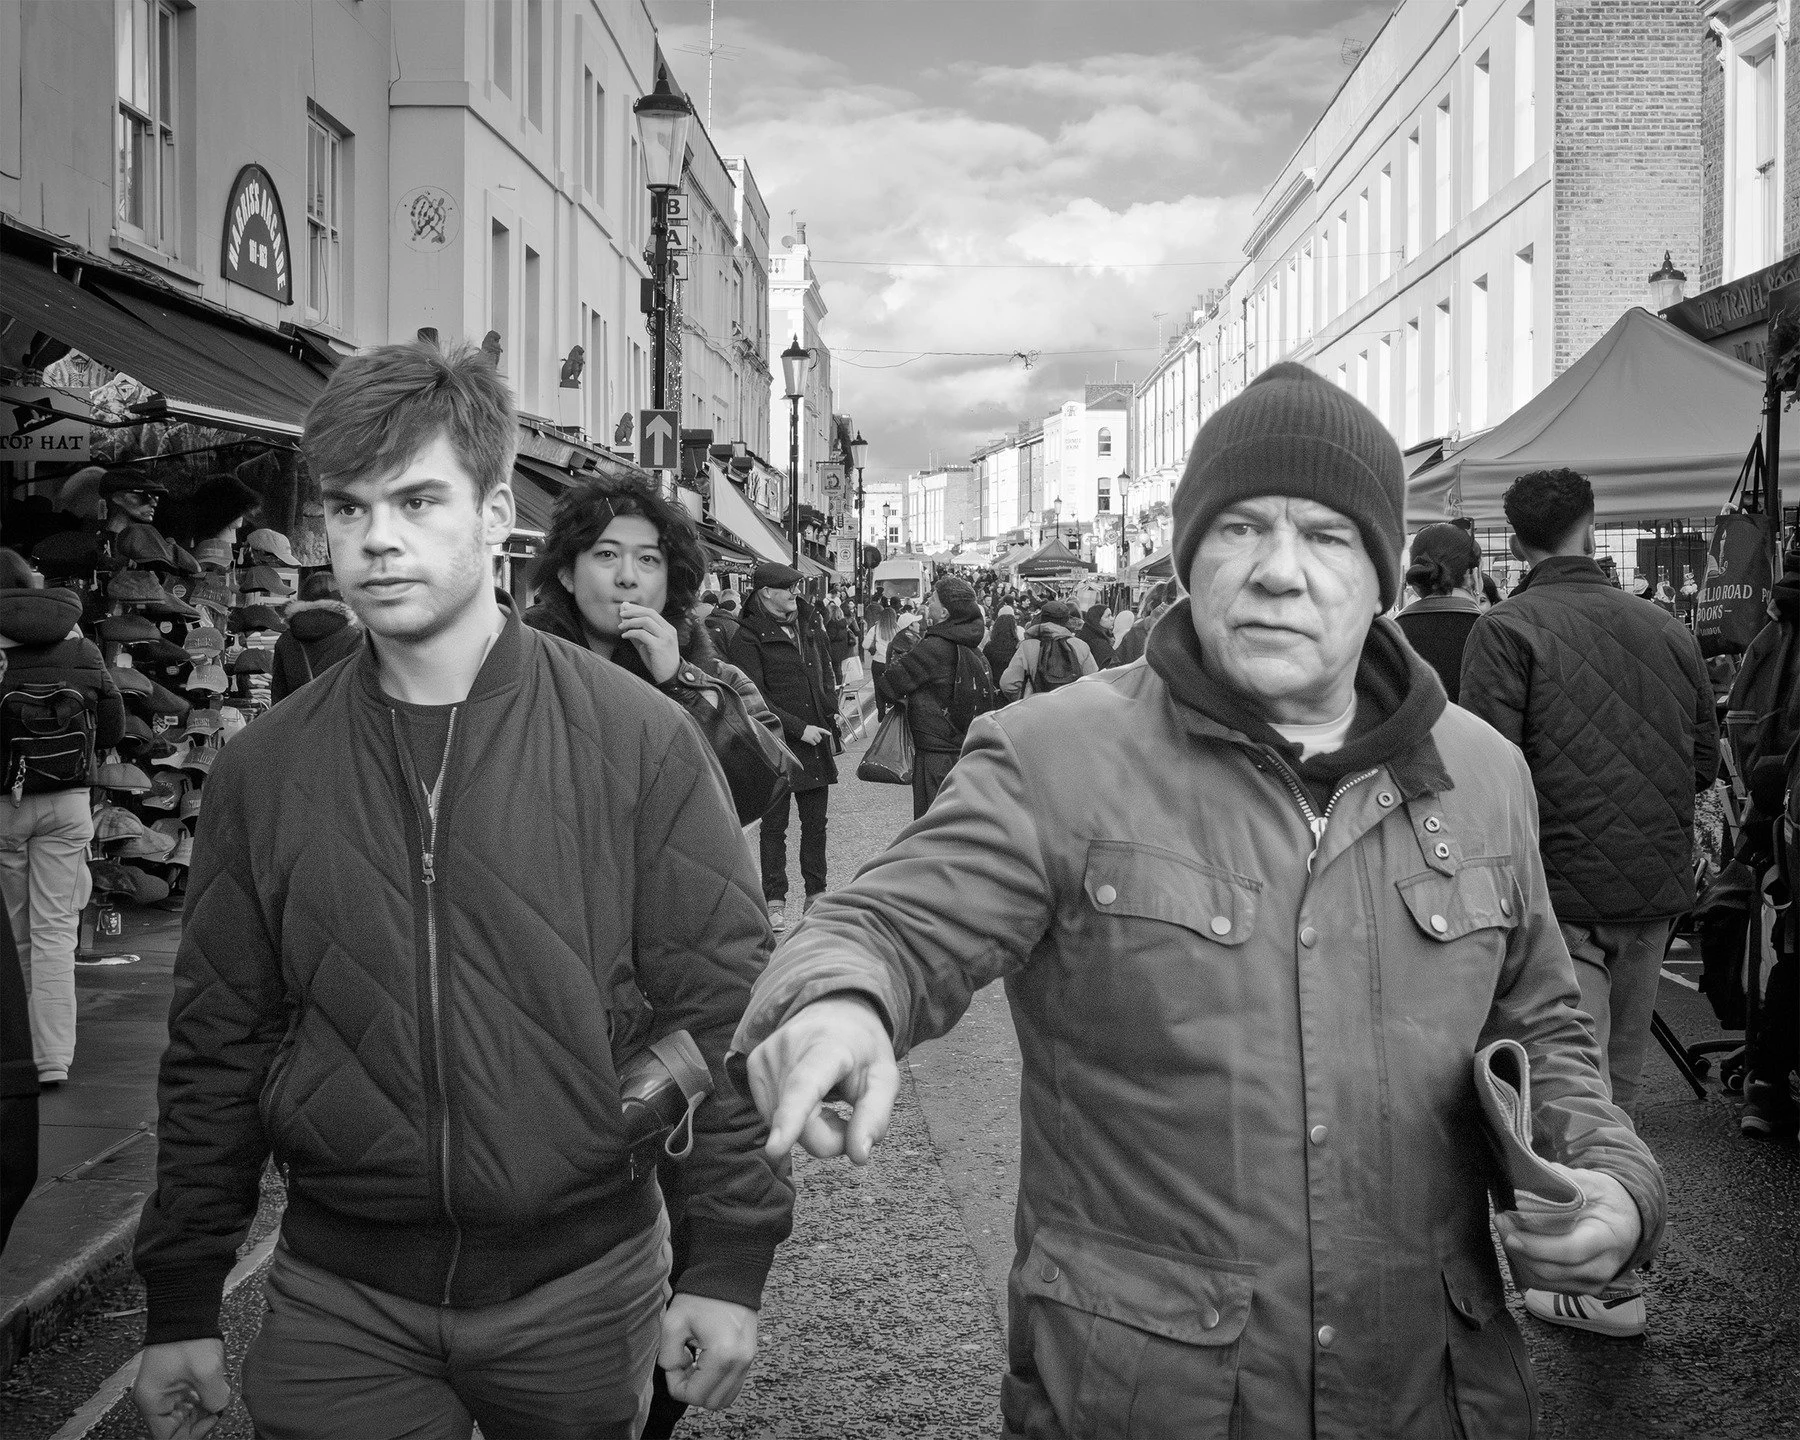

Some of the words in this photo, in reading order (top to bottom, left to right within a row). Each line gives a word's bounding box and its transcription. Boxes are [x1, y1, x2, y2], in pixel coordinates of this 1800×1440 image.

[260, 188, 286, 291] ARCADE
[1700, 301, 1722, 329] THE
[1720, 283, 1767, 320] TRAVEL
[0, 435, 34, 450] TOP
[40, 434, 84, 450] HAT
[1721, 584, 1753, 600] ROAD
